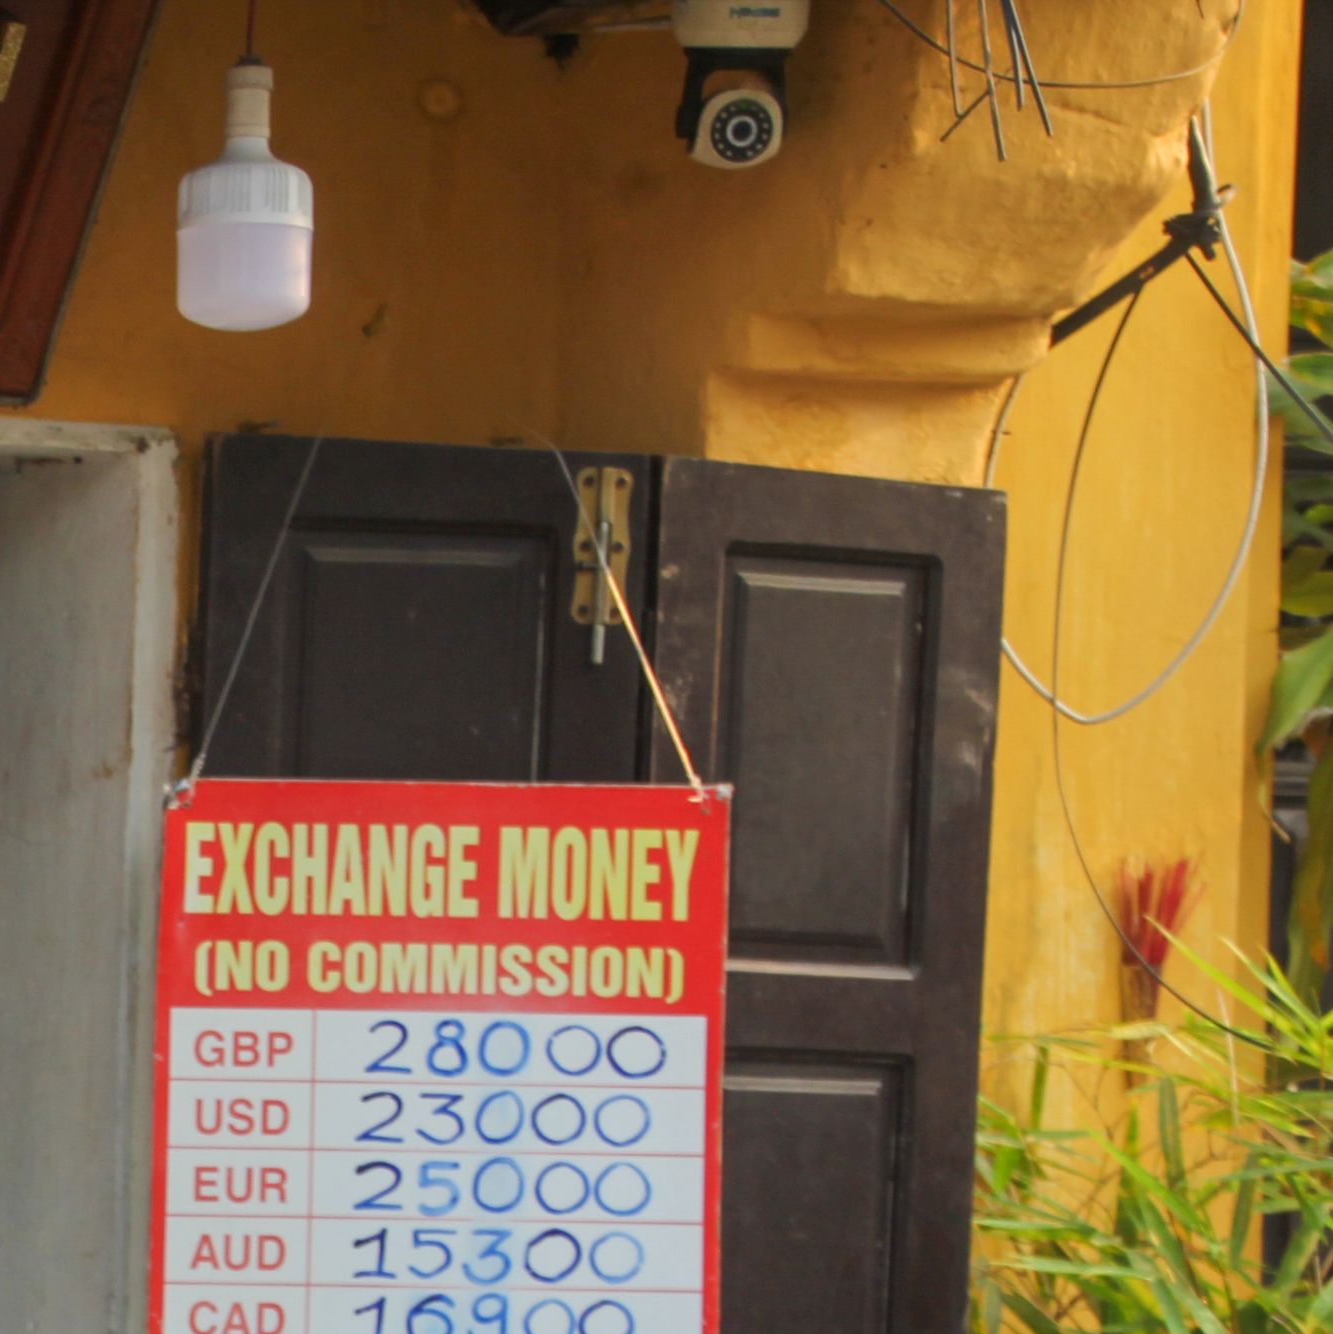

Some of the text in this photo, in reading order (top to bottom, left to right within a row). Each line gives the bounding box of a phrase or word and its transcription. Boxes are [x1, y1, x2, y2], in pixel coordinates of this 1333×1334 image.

[183, 821, 700, 922] EXCHANGE MONEY
[194, 940, 686, 1005] (NO COMMISSION)
[194, 1019, 667, 1079] GBP 28000
[195, 1090, 651, 1148] USD 23000
[194, 1156, 652, 1217] EUR 25000
[190, 1228, 645, 1284] AUD 15300
